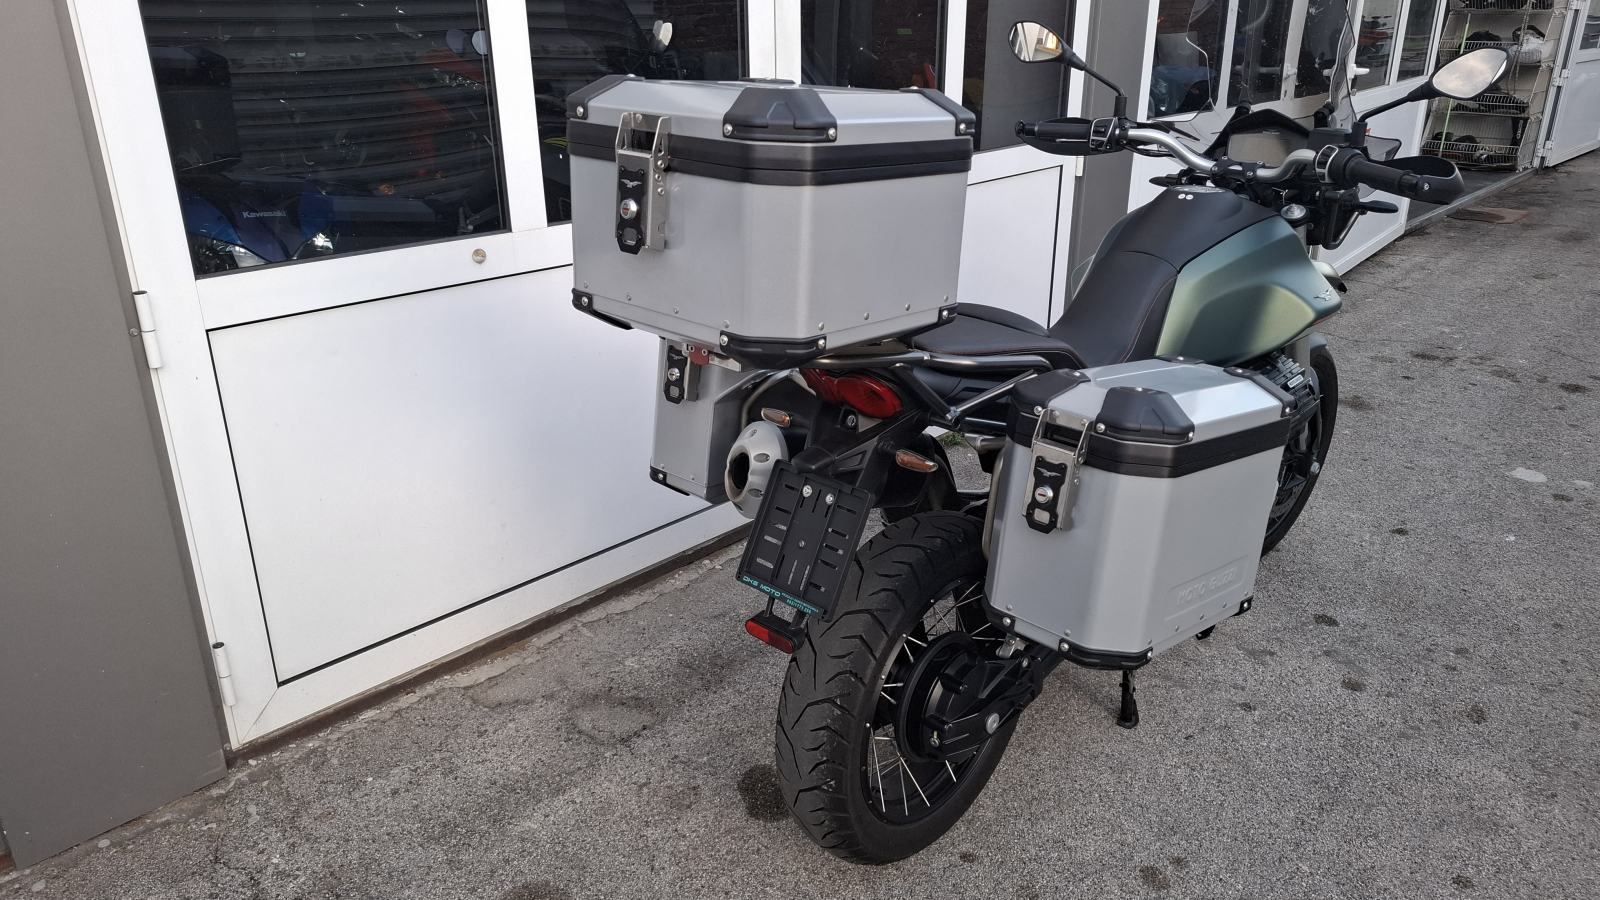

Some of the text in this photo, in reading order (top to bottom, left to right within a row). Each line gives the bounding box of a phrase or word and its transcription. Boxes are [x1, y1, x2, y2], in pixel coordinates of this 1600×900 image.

[242, 210, 287, 219] Kawasaki
[760, 584, 781, 597] MOTO
[1176, 582, 1206, 605] MOTO
